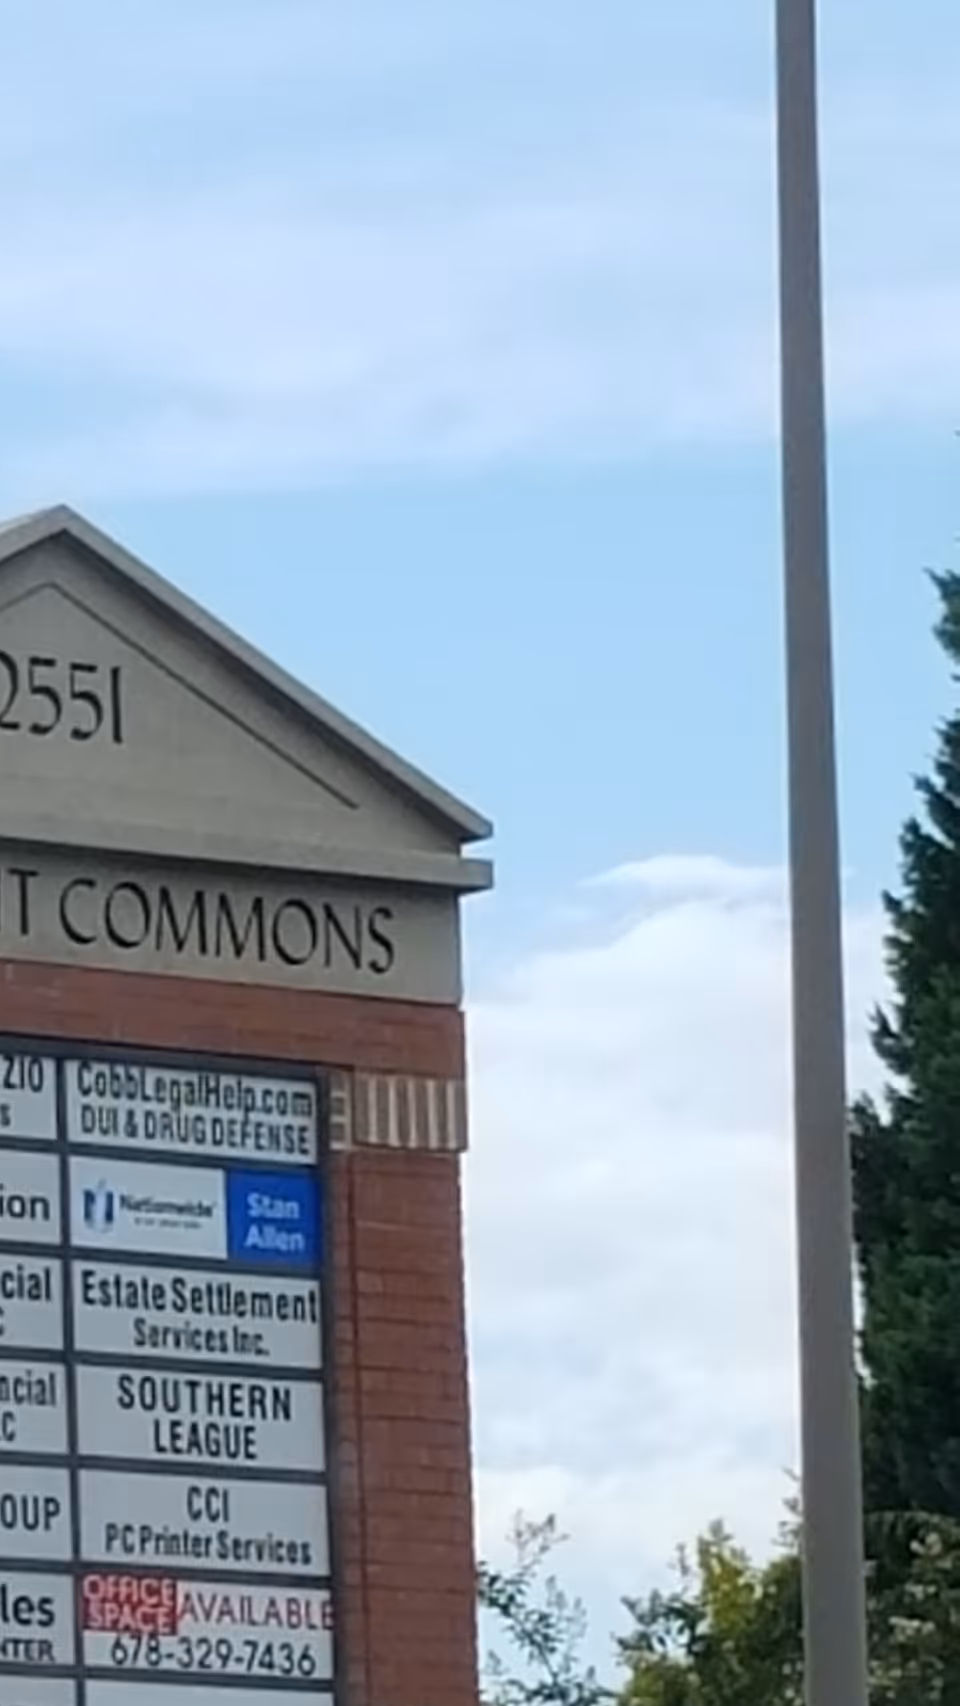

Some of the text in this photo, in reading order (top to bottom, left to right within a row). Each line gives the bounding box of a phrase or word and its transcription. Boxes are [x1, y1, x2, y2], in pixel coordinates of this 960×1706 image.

[59, 878, 396, 974] COMMONS
[77, 1061, 313, 1122] CobbLegalHelp.com
[81, 1104, 310, 1155] DUI & DRUG DEFENSE
[119, 1193, 214, 1219] Nationwide
[246, 1192, 301, 1219] Stan
[244, 1224, 306, 1253] Allen
[82, 1269, 319, 1324] Estate Settlement
[133, 1317, 271, 1357] Services Inc.
[116, 1373, 291, 1422] SOUTHERN
[152, 1418, 259, 1460] LEAGUE
[186, 1485, 230, 1523] CCI
[105, 1522, 312, 1566] PC Printer Services
[83, 1574, 175, 1607] OFFICE
[178, 1591, 334, 1631] AVAILABLE
[88, 1602, 174, 1635] SPACE
[111, 1634, 316, 1677] 678-329-7436
